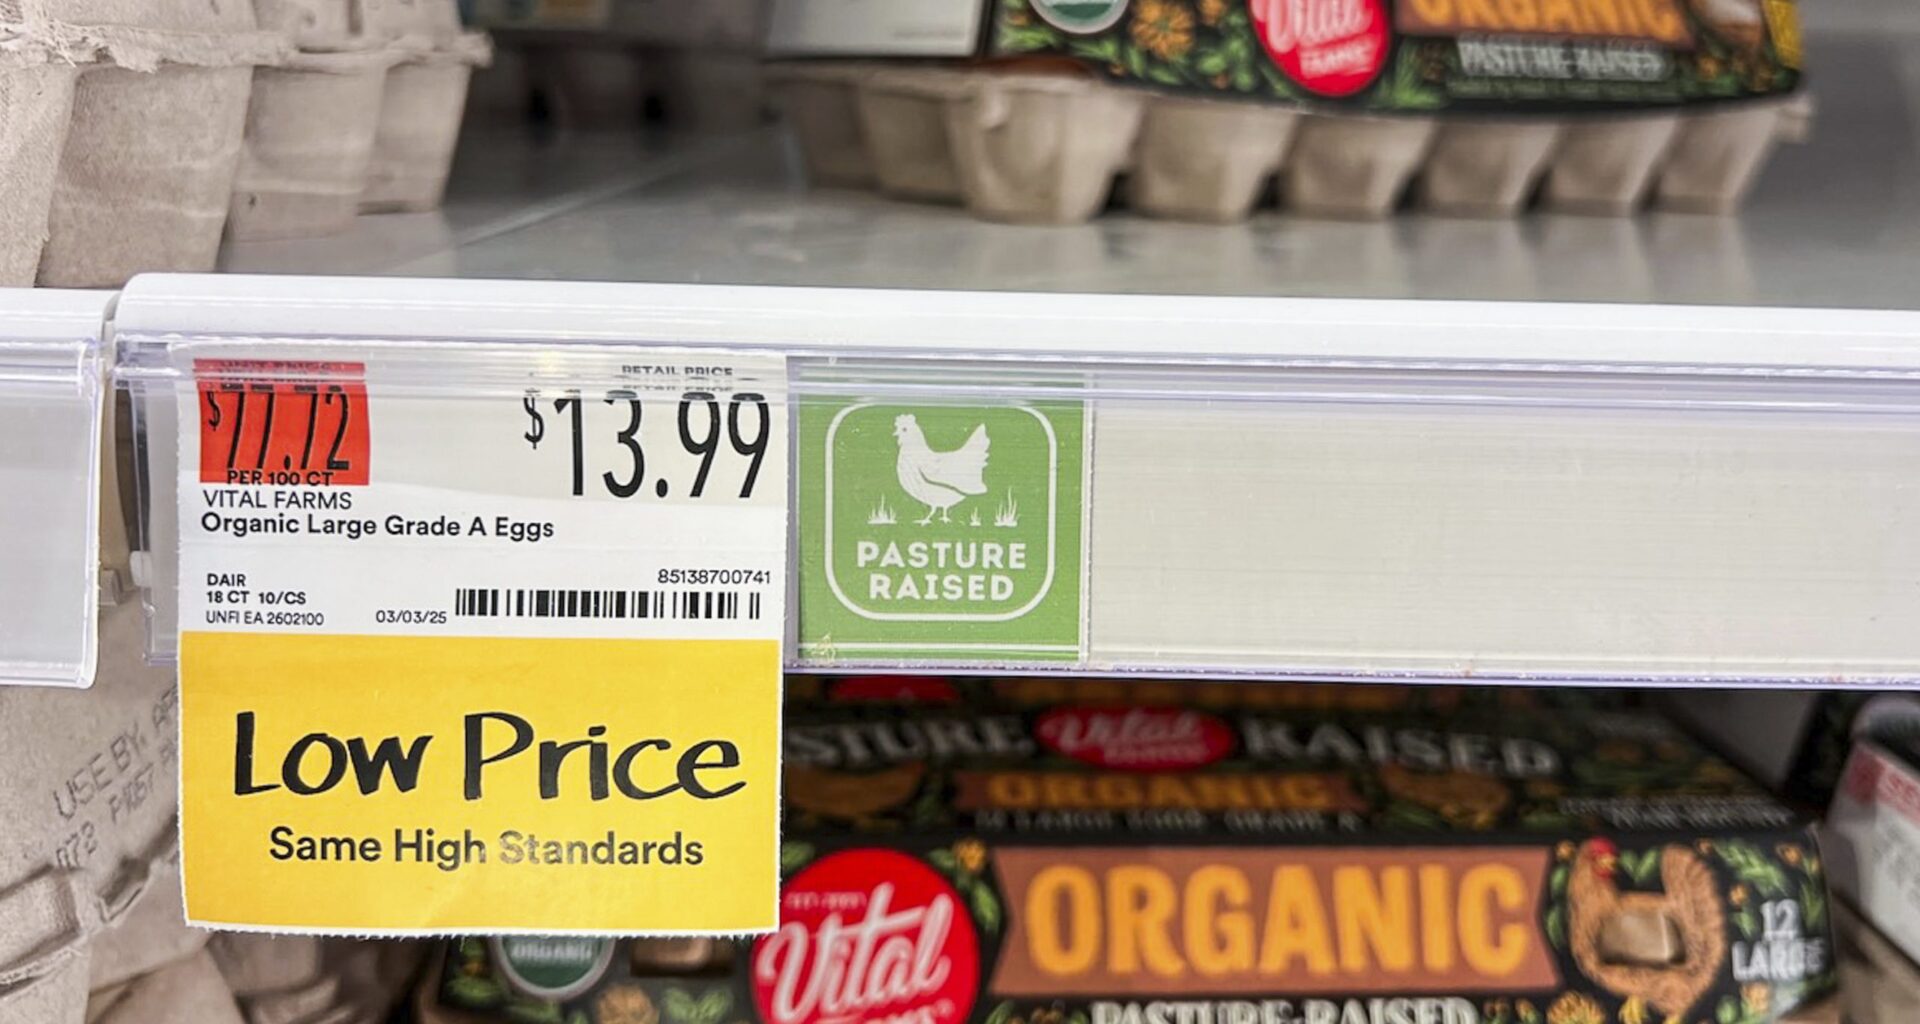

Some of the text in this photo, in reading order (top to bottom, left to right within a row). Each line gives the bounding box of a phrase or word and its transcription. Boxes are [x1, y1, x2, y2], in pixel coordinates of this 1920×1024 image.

[523, 389, 771, 499] $13.99
[227, 471, 334, 487] PER 100 CT
[203, 490, 352, 510] VITAL FARMS
[201, 512, 555, 542] Organic Large Grade A Eggs
[857, 541, 1027, 570] PASTURE
[207, 573, 247, 587] DAIR
[657, 568, 771, 585] 85138700741
[868, 573, 1015, 601] RAISED
[207, 590, 307, 606] 18 CT 10/CS
[206, 610, 324, 626] UNFI EA 2602100
[375, 609, 448, 625] 03/03/25
[782, 712, 1034, 766] STURE
[233, 711, 749, 802] Low Price
[53, 752, 114, 821] USE
[269, 825, 705, 872] Same High Standards
[1024, 864, 1530, 978] ORGANIC
[1760, 899, 1800, 941] 12
[755, 881, 955, 1023] Vital
